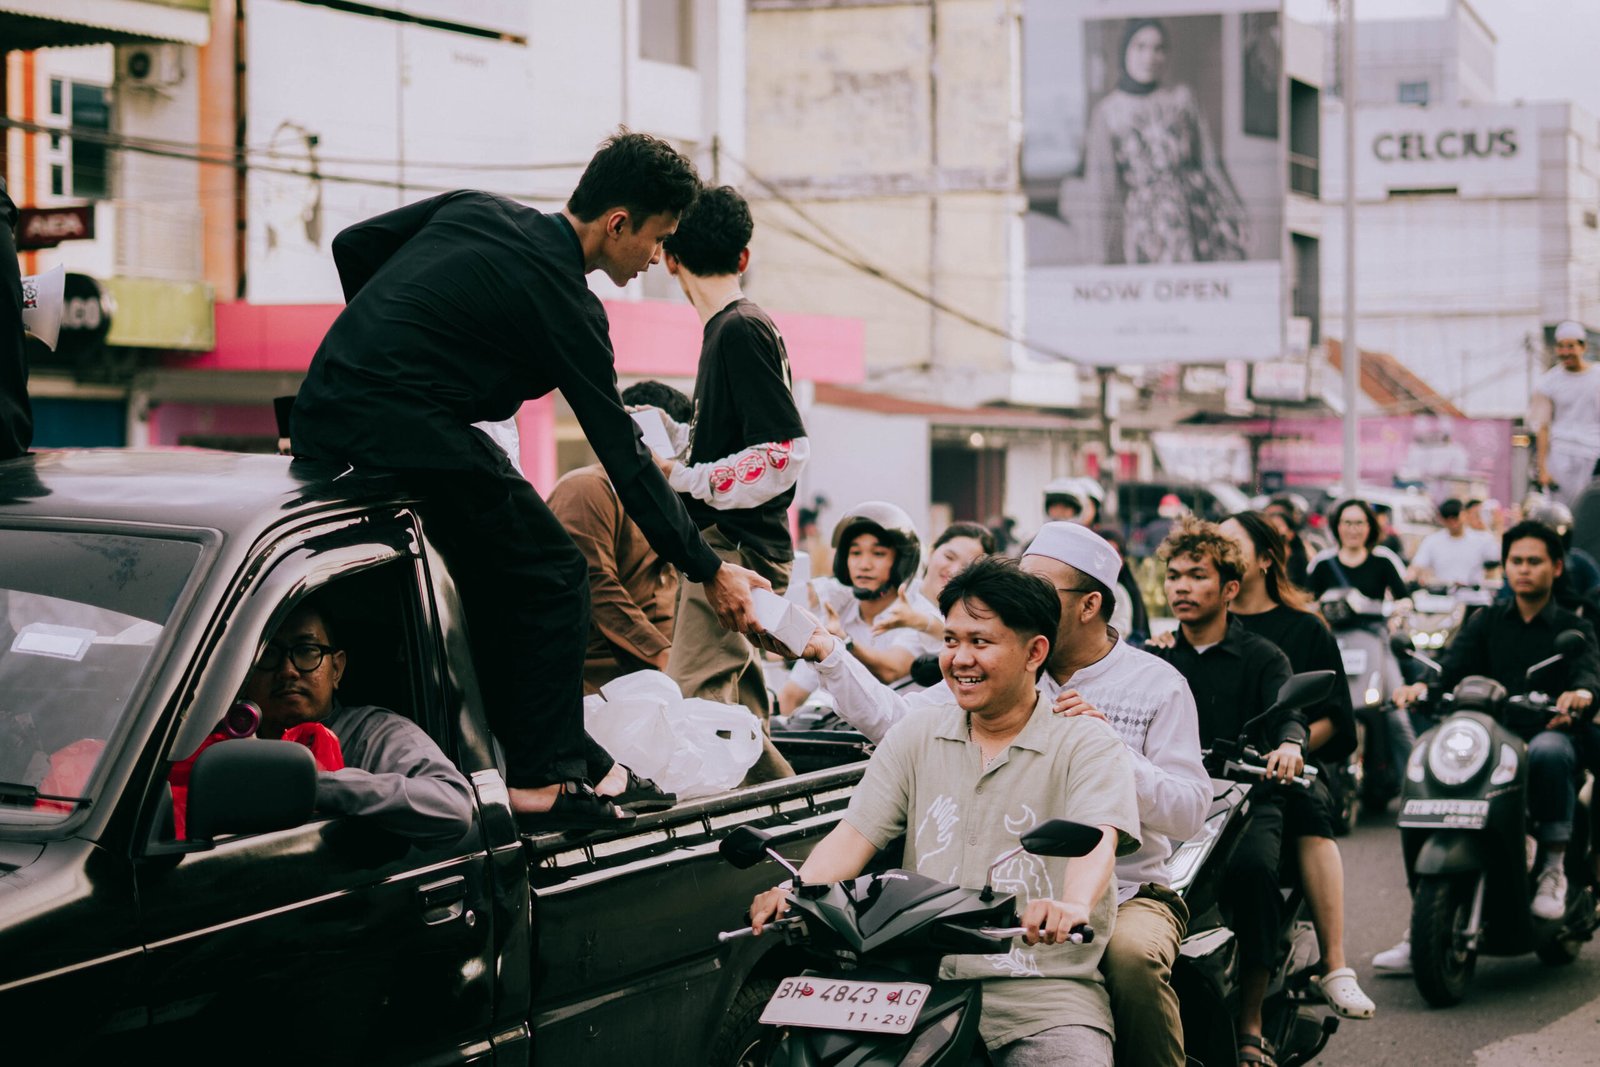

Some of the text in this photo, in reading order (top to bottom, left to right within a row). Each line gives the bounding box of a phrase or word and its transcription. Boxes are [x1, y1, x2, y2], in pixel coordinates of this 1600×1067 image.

[1372, 128, 1519, 164] CELCIUS
[1073, 277, 1231, 303] NOW OPEN
[876, 873, 909, 881] HONDA
[777, 981, 922, 1007] BH 4843 AG
